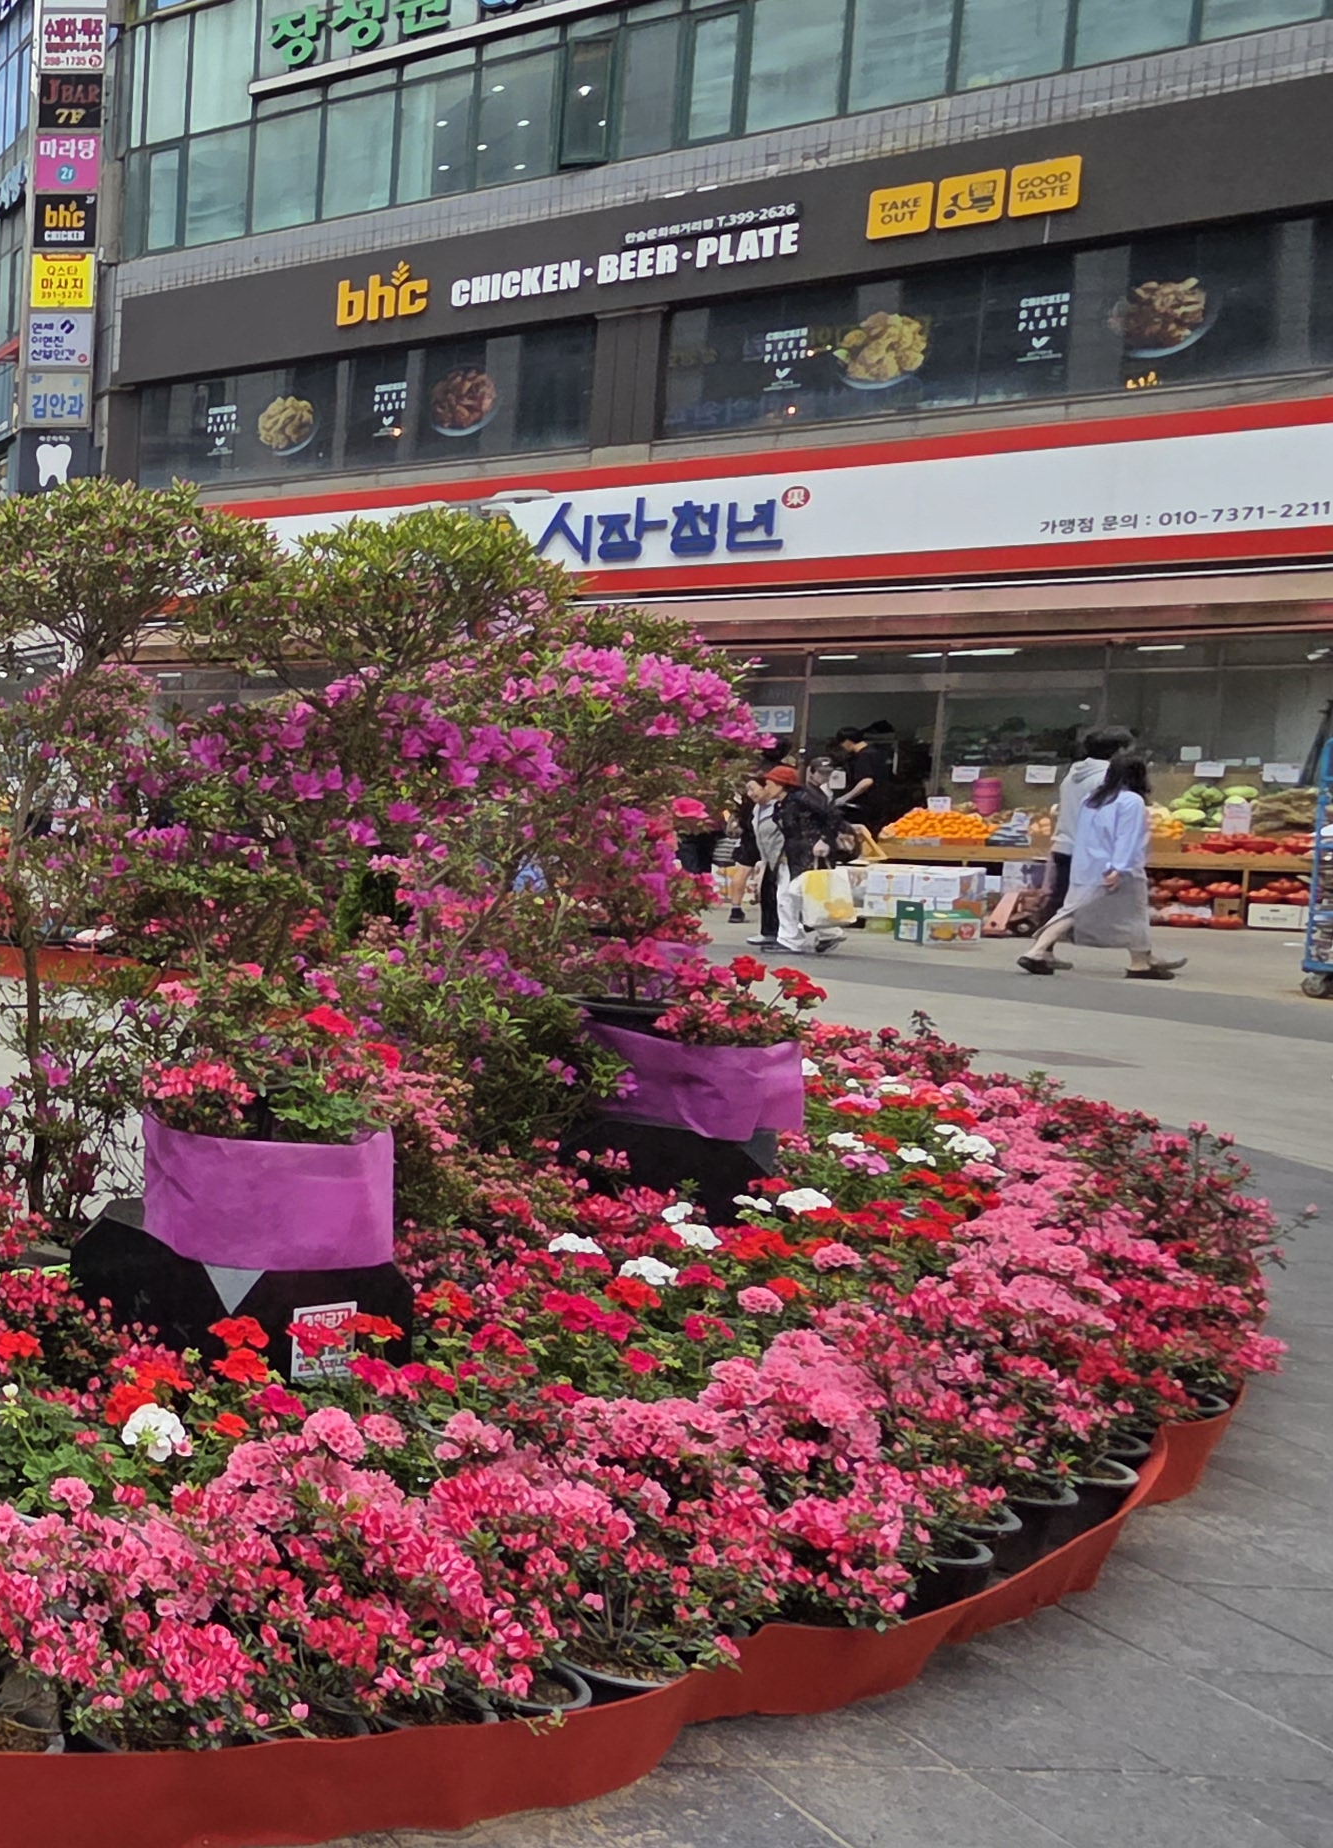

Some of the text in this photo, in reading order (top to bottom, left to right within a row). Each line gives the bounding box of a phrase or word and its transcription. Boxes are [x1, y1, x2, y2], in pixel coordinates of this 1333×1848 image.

[1017, 171, 1072, 191] GOOD
[1016, 184, 1070, 203] TASTE
[44, 201, 85, 228] bhc
[879, 196, 922, 213] TAKE
[716, 203, 796, 227] T.399-2626
[880, 210, 917, 225] OUT
[46, 266, 79, 277] Q스타
[41, 278, 84, 289] 마사지
[336, 261, 429, 328] bhc
[31, 393, 84, 419] 김안과
[1039, 517, 1085, 534] 가맹점
[1101, 514, 1138, 532] 문의
[1158, 501, 1331, 526] 010-7371-2211
